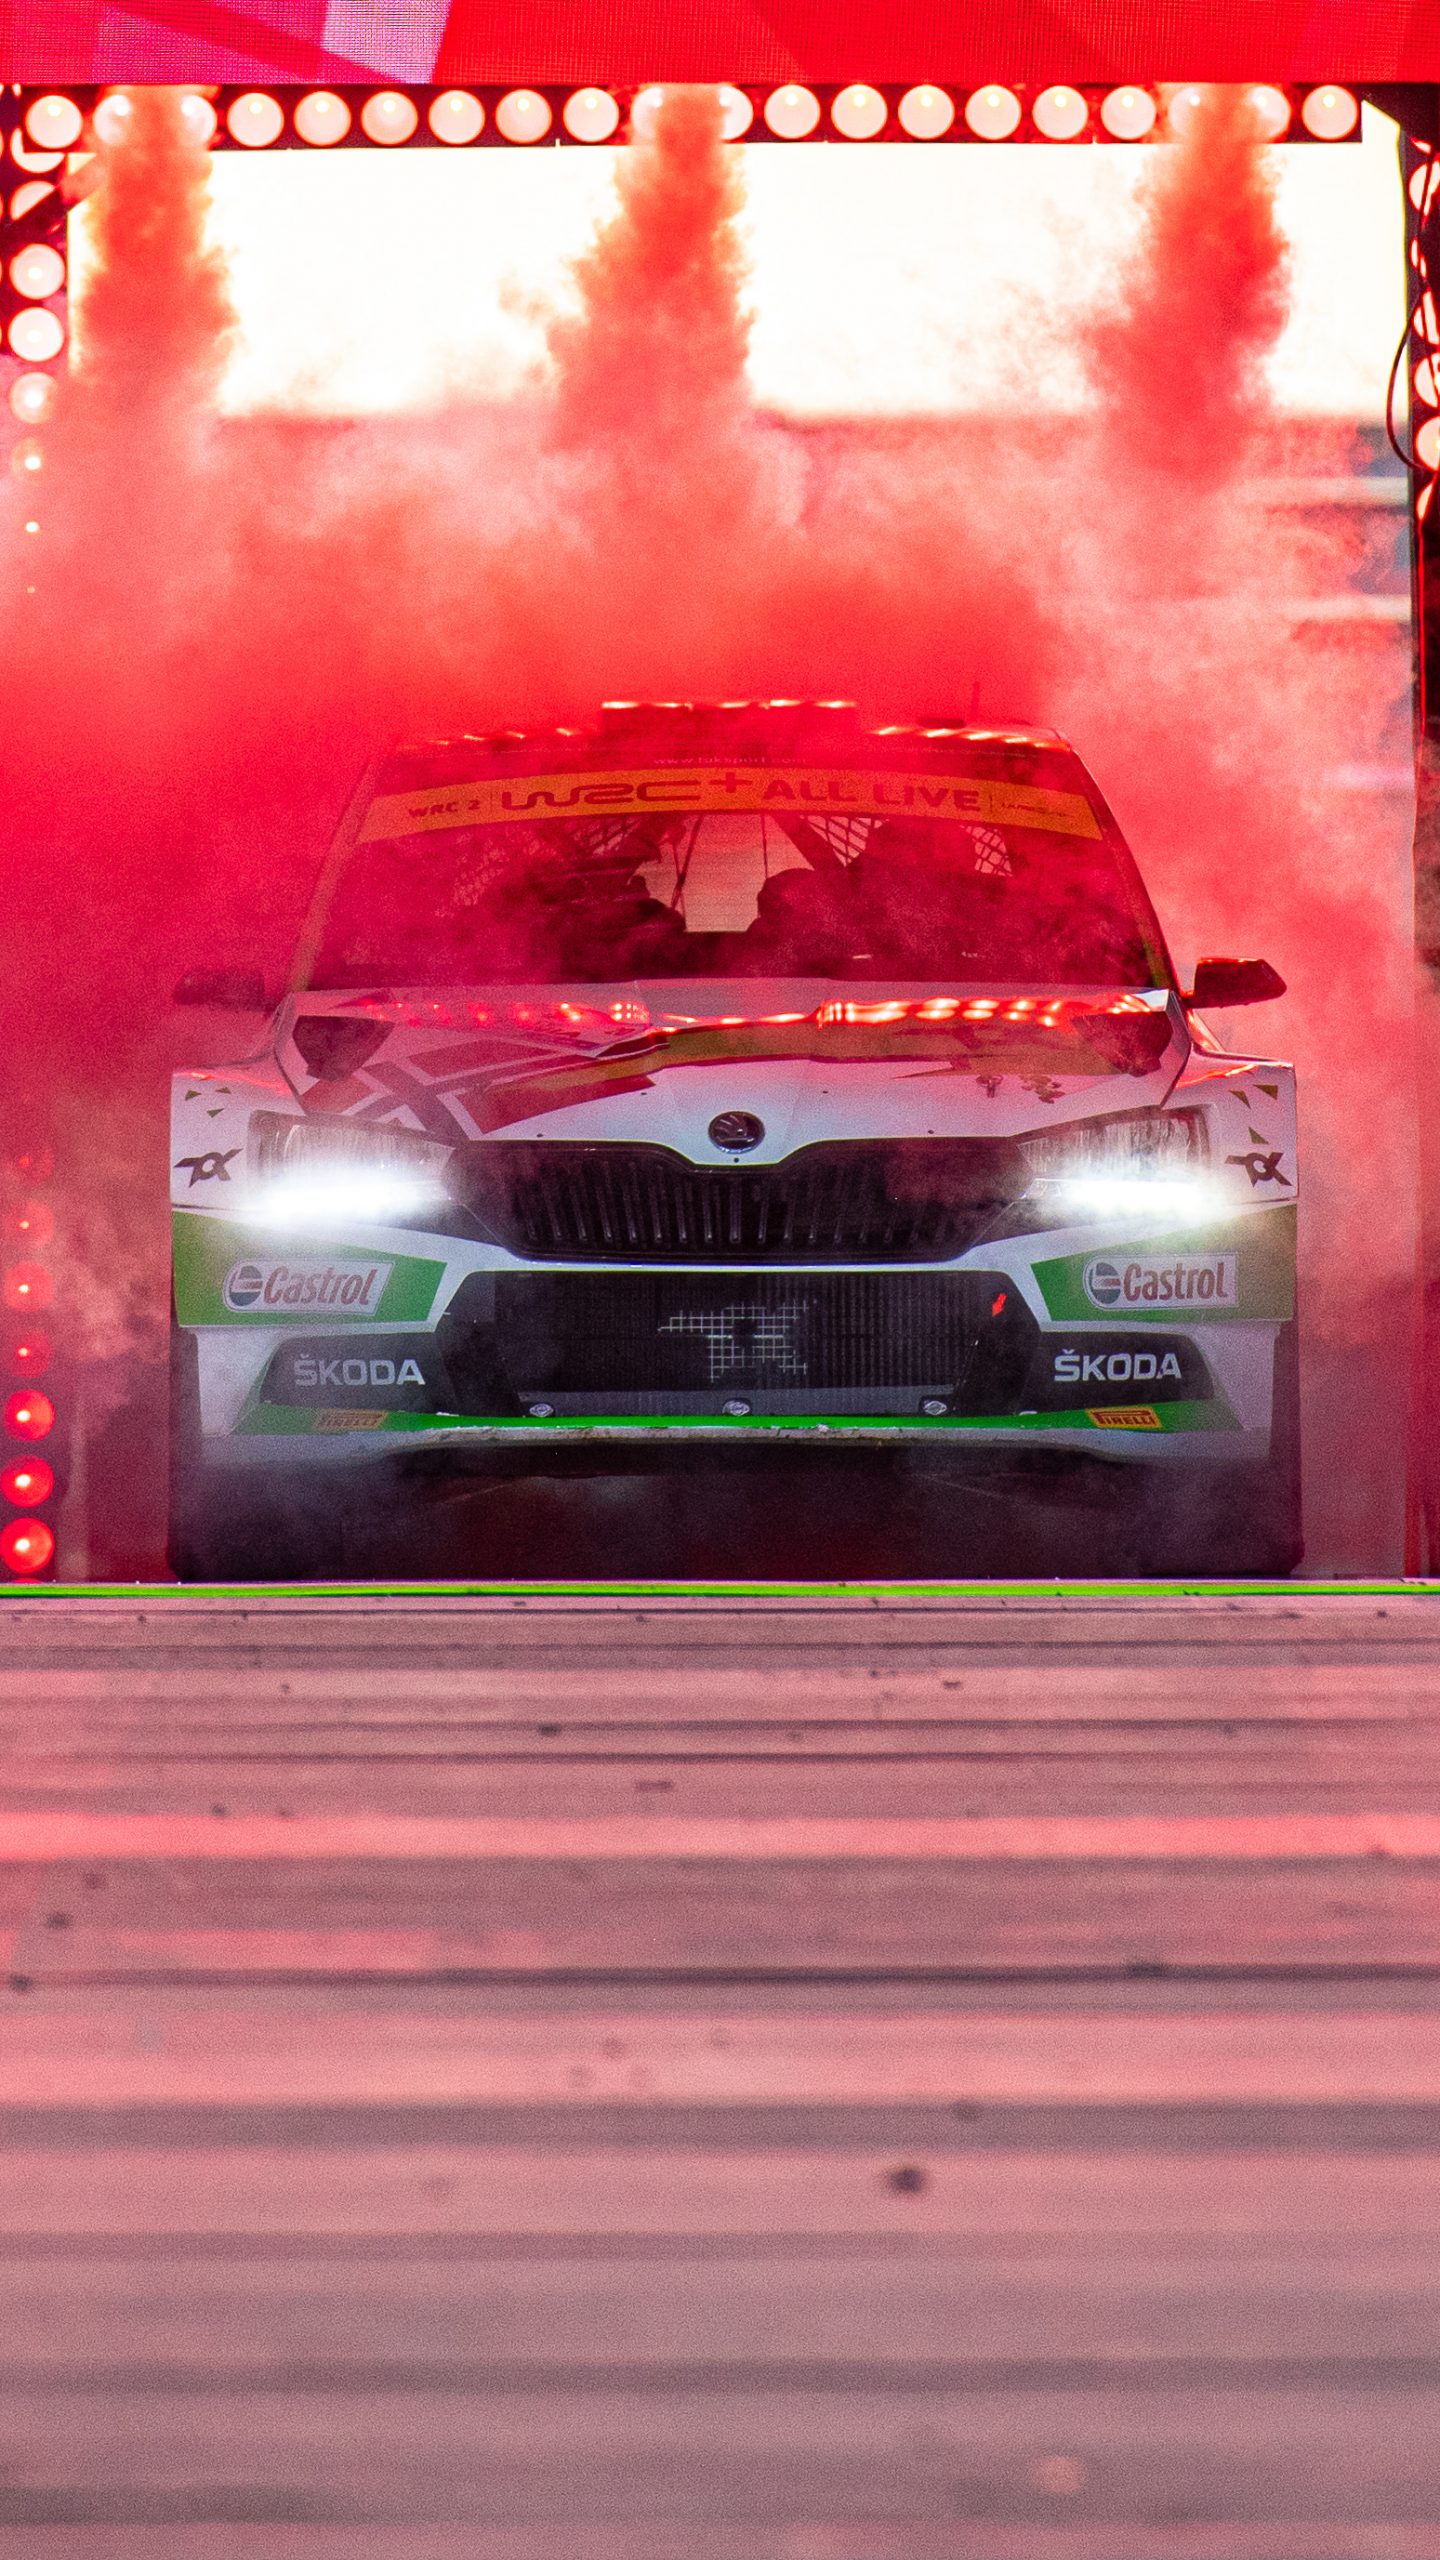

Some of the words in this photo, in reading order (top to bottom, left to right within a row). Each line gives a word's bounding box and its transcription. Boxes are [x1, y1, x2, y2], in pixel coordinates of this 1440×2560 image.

[408, 801, 458, 818] WRC
[468, 799, 480, 811] 2
[762, 779, 858, 802] ALL
[872, 783, 981, 812] LIVE
[264, 1266, 377, 1306] Castrol
[1123, 1261, 1228, 1302] Castrol
[293, 1353, 426, 1387] ŠKODA
[1053, 1349, 1182, 1383] ŠKODA
[1091, 1410, 1156, 1425] PIRELLI
